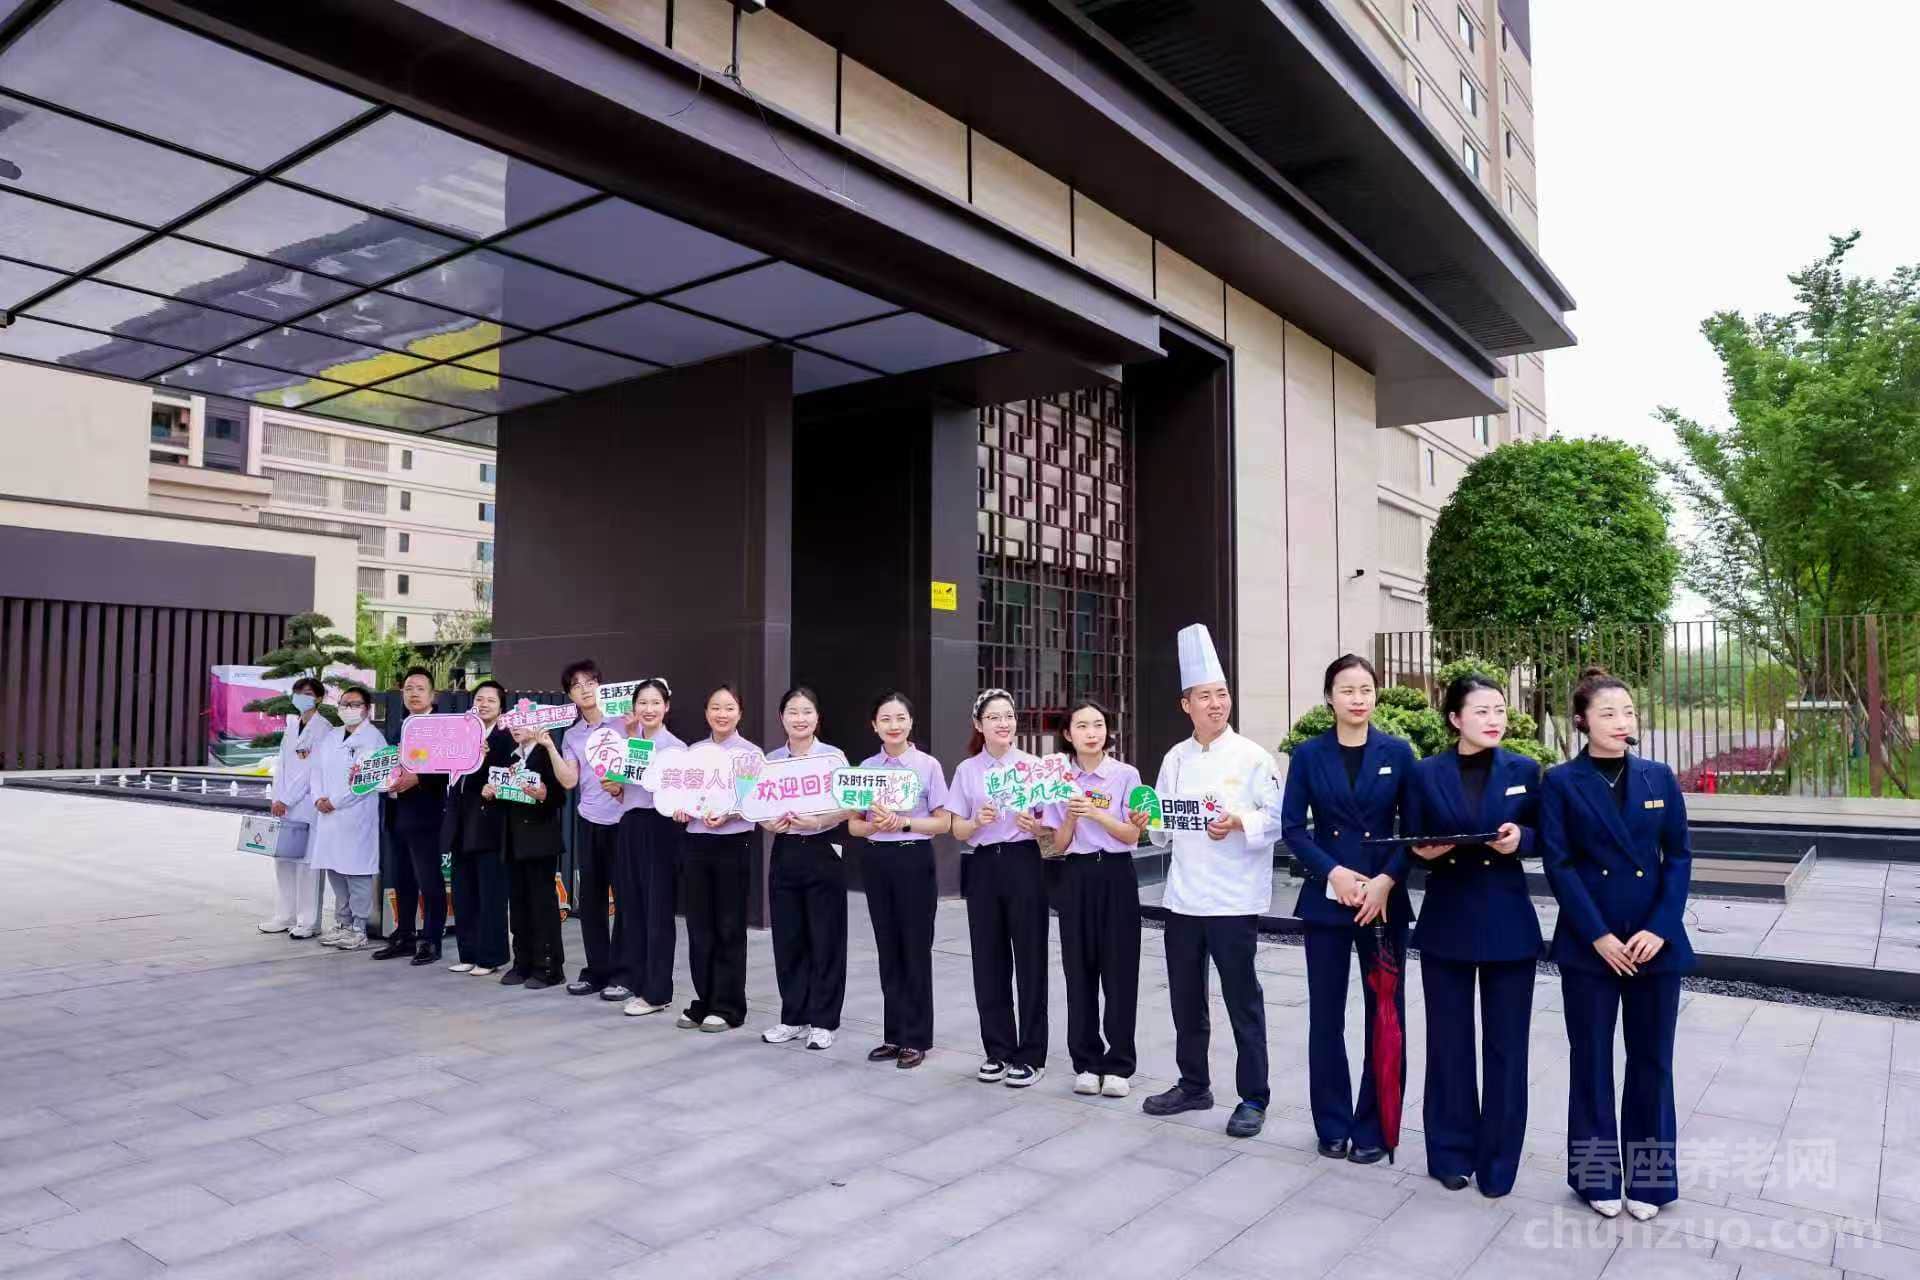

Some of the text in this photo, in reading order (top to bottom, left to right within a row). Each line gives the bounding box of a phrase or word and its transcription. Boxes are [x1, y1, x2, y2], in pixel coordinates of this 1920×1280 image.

[661, 768, 732, 790] 芙蓉人
[838, 774, 887, 787] 及时行乐
